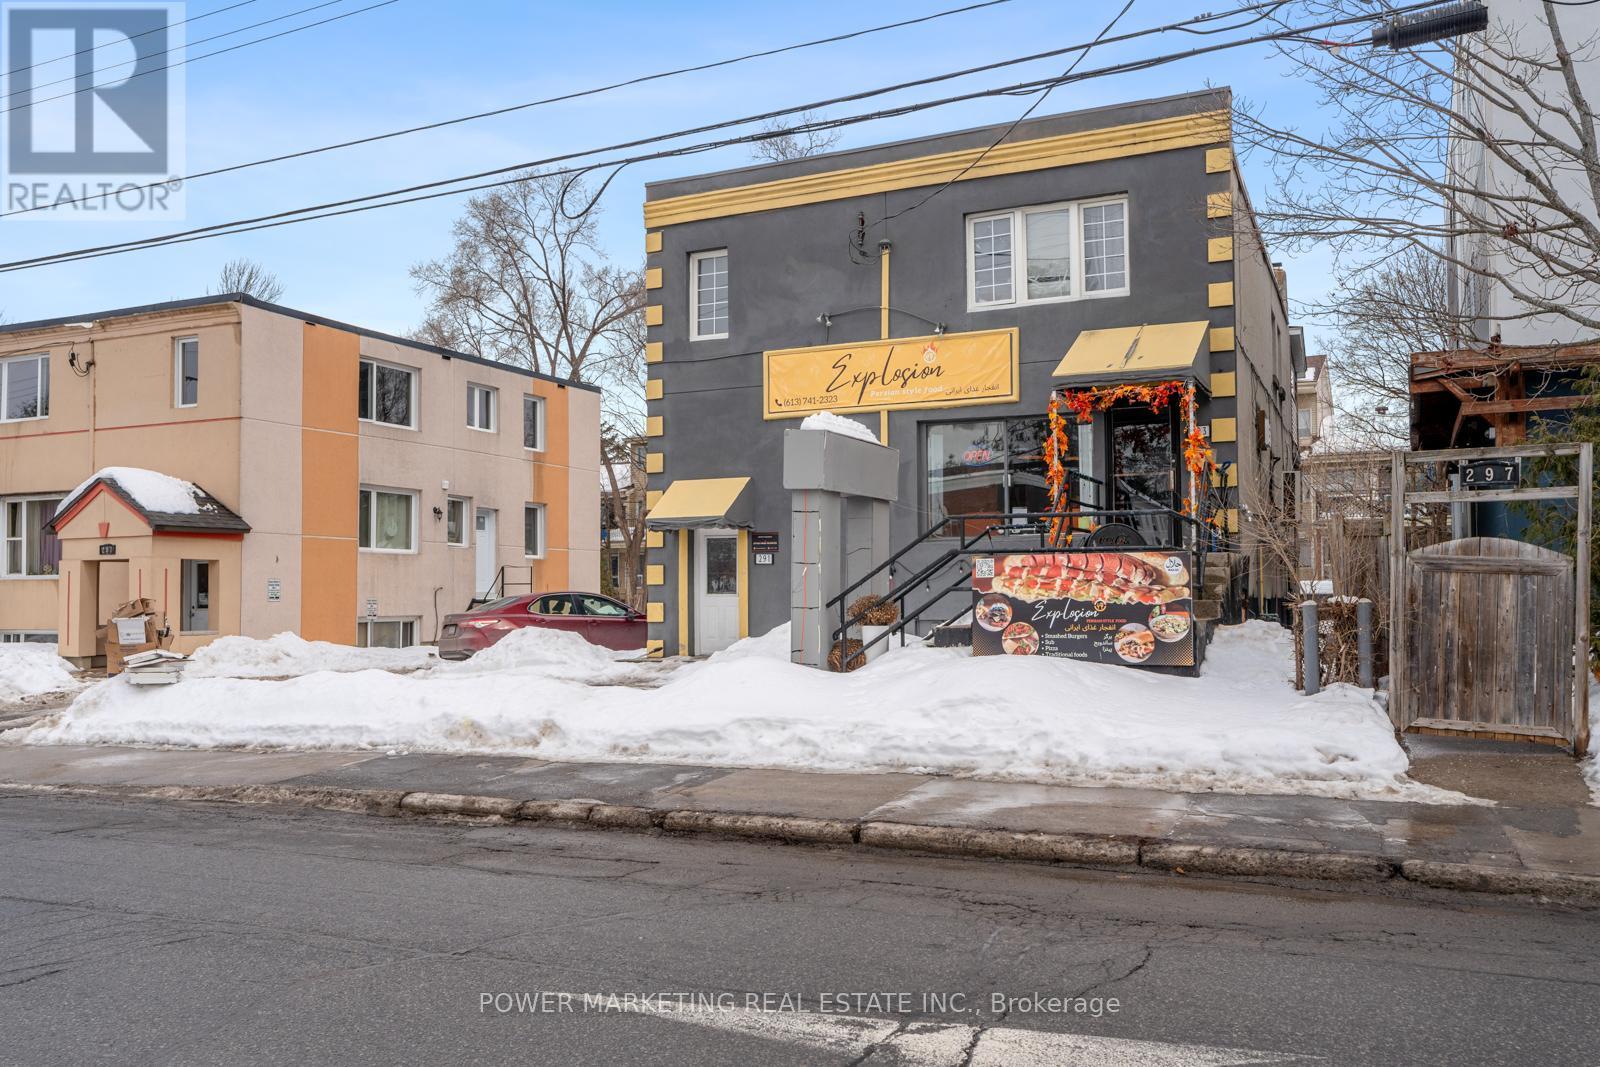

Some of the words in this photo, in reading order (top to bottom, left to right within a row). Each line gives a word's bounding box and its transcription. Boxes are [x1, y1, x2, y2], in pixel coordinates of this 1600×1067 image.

[825, 345, 945, 405] Explosion
[870, 389, 899, 397] Persian
[902, 387, 922, 397] style
[923, 386, 944, 395] food
[783, 397, 801, 407] (613)
[802, 395, 838, 405] 741-2323
[963, 449, 992, 462] OPEN
[1466, 467, 1514, 482] 297
[758, 554, 771, 563] 291
[1031, 598, 1099, 629] Explosion
